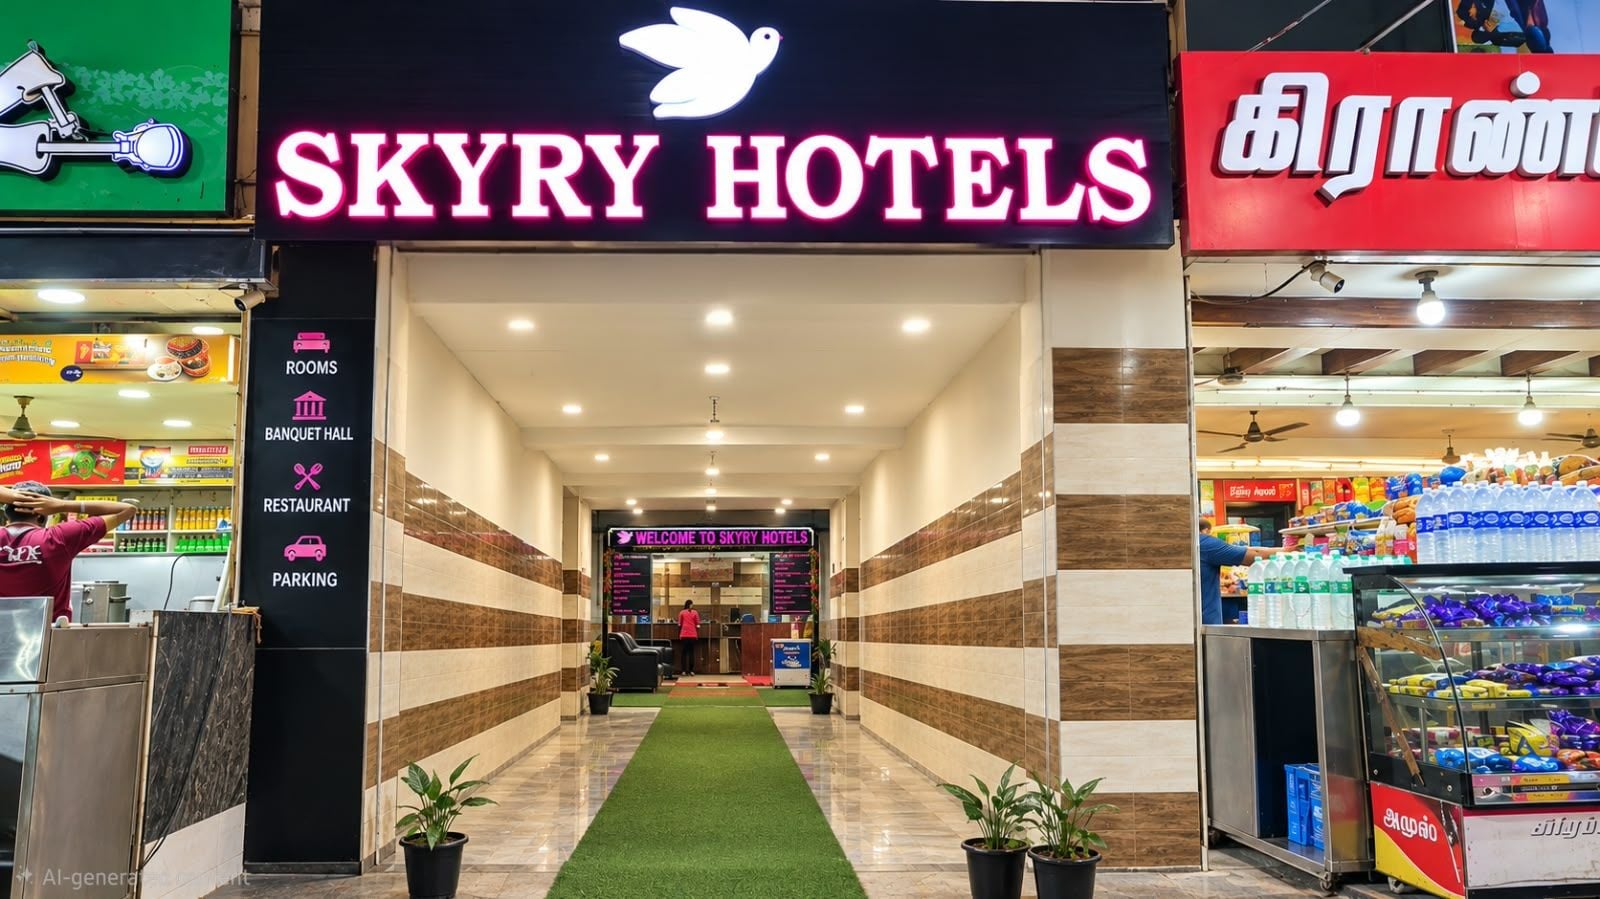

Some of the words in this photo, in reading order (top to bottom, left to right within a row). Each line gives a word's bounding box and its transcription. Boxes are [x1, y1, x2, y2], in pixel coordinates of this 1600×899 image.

[1218, 71, 1600, 200] கிராண்
[275, 131, 660, 218] SKYRY
[705, 134, 1152, 223] HOTELS
[286, 360, 338, 375] ROOMS
[265, 427, 322, 442] BANQUET
[323, 427, 354, 441] HALL
[263, 498, 351, 513] RESTAURANT
[635, 531, 697, 545] WELCOME
[699, 531, 716, 545] TO
[719, 531, 758, 545] SKYRY
[761, 530, 809, 544] HOTELS
[272, 572, 338, 587] PARKING
